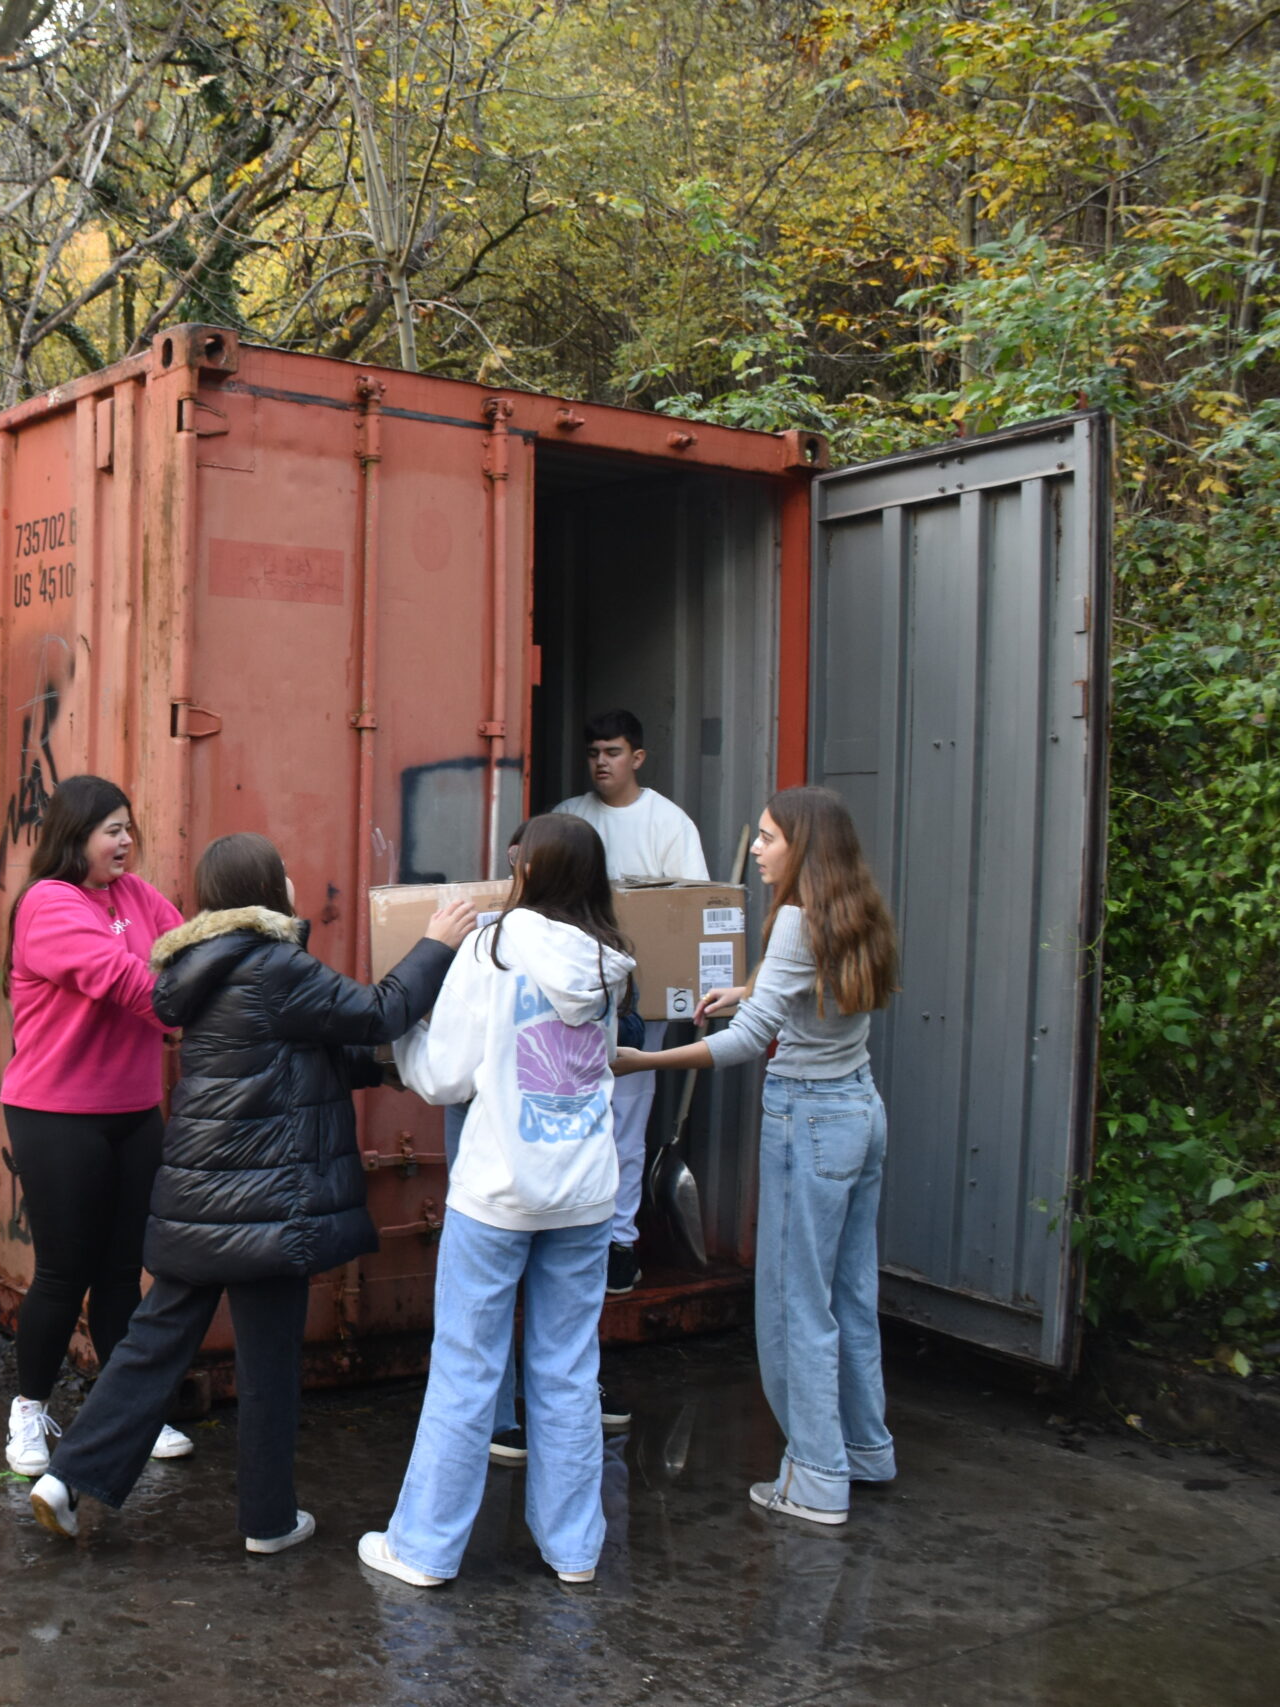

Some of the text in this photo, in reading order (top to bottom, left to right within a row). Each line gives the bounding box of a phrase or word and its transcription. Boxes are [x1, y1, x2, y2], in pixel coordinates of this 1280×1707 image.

[15, 511, 65, 558] 735702
[14, 562, 74, 608] US 4510
